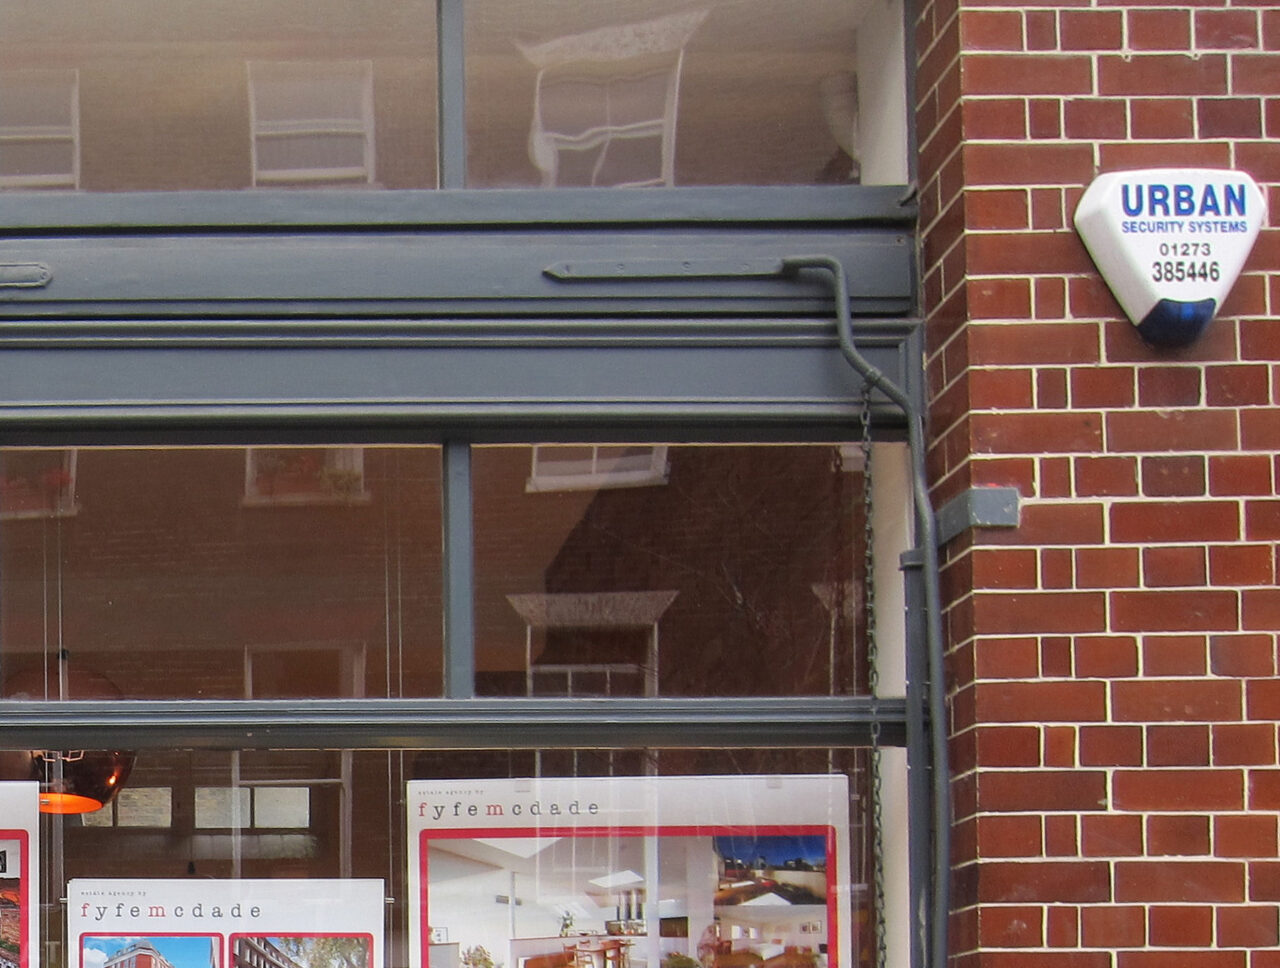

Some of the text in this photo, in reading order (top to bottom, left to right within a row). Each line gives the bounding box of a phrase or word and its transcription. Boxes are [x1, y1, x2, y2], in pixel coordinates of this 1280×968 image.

[1122, 184, 1247, 217] URBAN
[1122, 222, 1248, 233] SECURITY SYSTEMS
[1160, 243, 1211, 256] 01273
[1152, 262, 1220, 282] 385446
